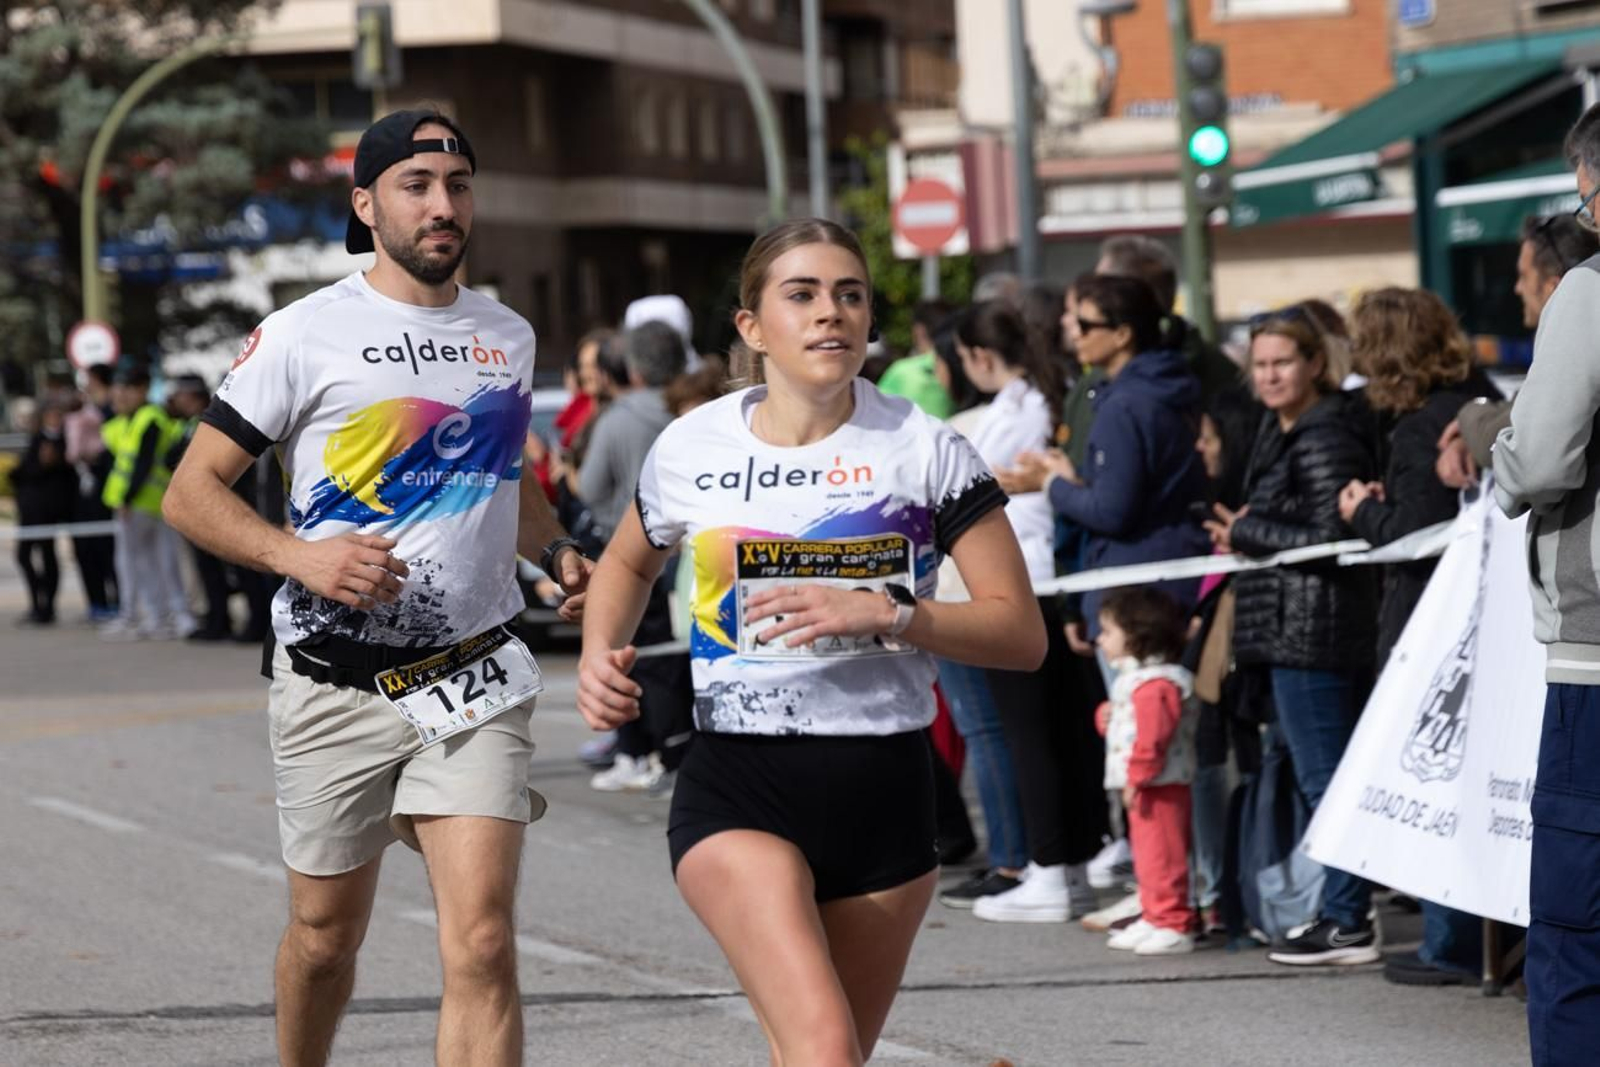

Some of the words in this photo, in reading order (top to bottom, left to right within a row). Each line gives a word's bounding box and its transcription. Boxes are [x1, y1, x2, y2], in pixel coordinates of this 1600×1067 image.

[783, 543, 843, 555] CARRERA
[845, 539, 903, 554] POPULAR
[783, 554, 792, 565] y
[799, 553, 834, 565] gran
[841, 549, 904, 564] caminata
[415, 673, 423, 683] y
[426, 656, 508, 714] 124
[1401, 799, 1429, 828] DE
